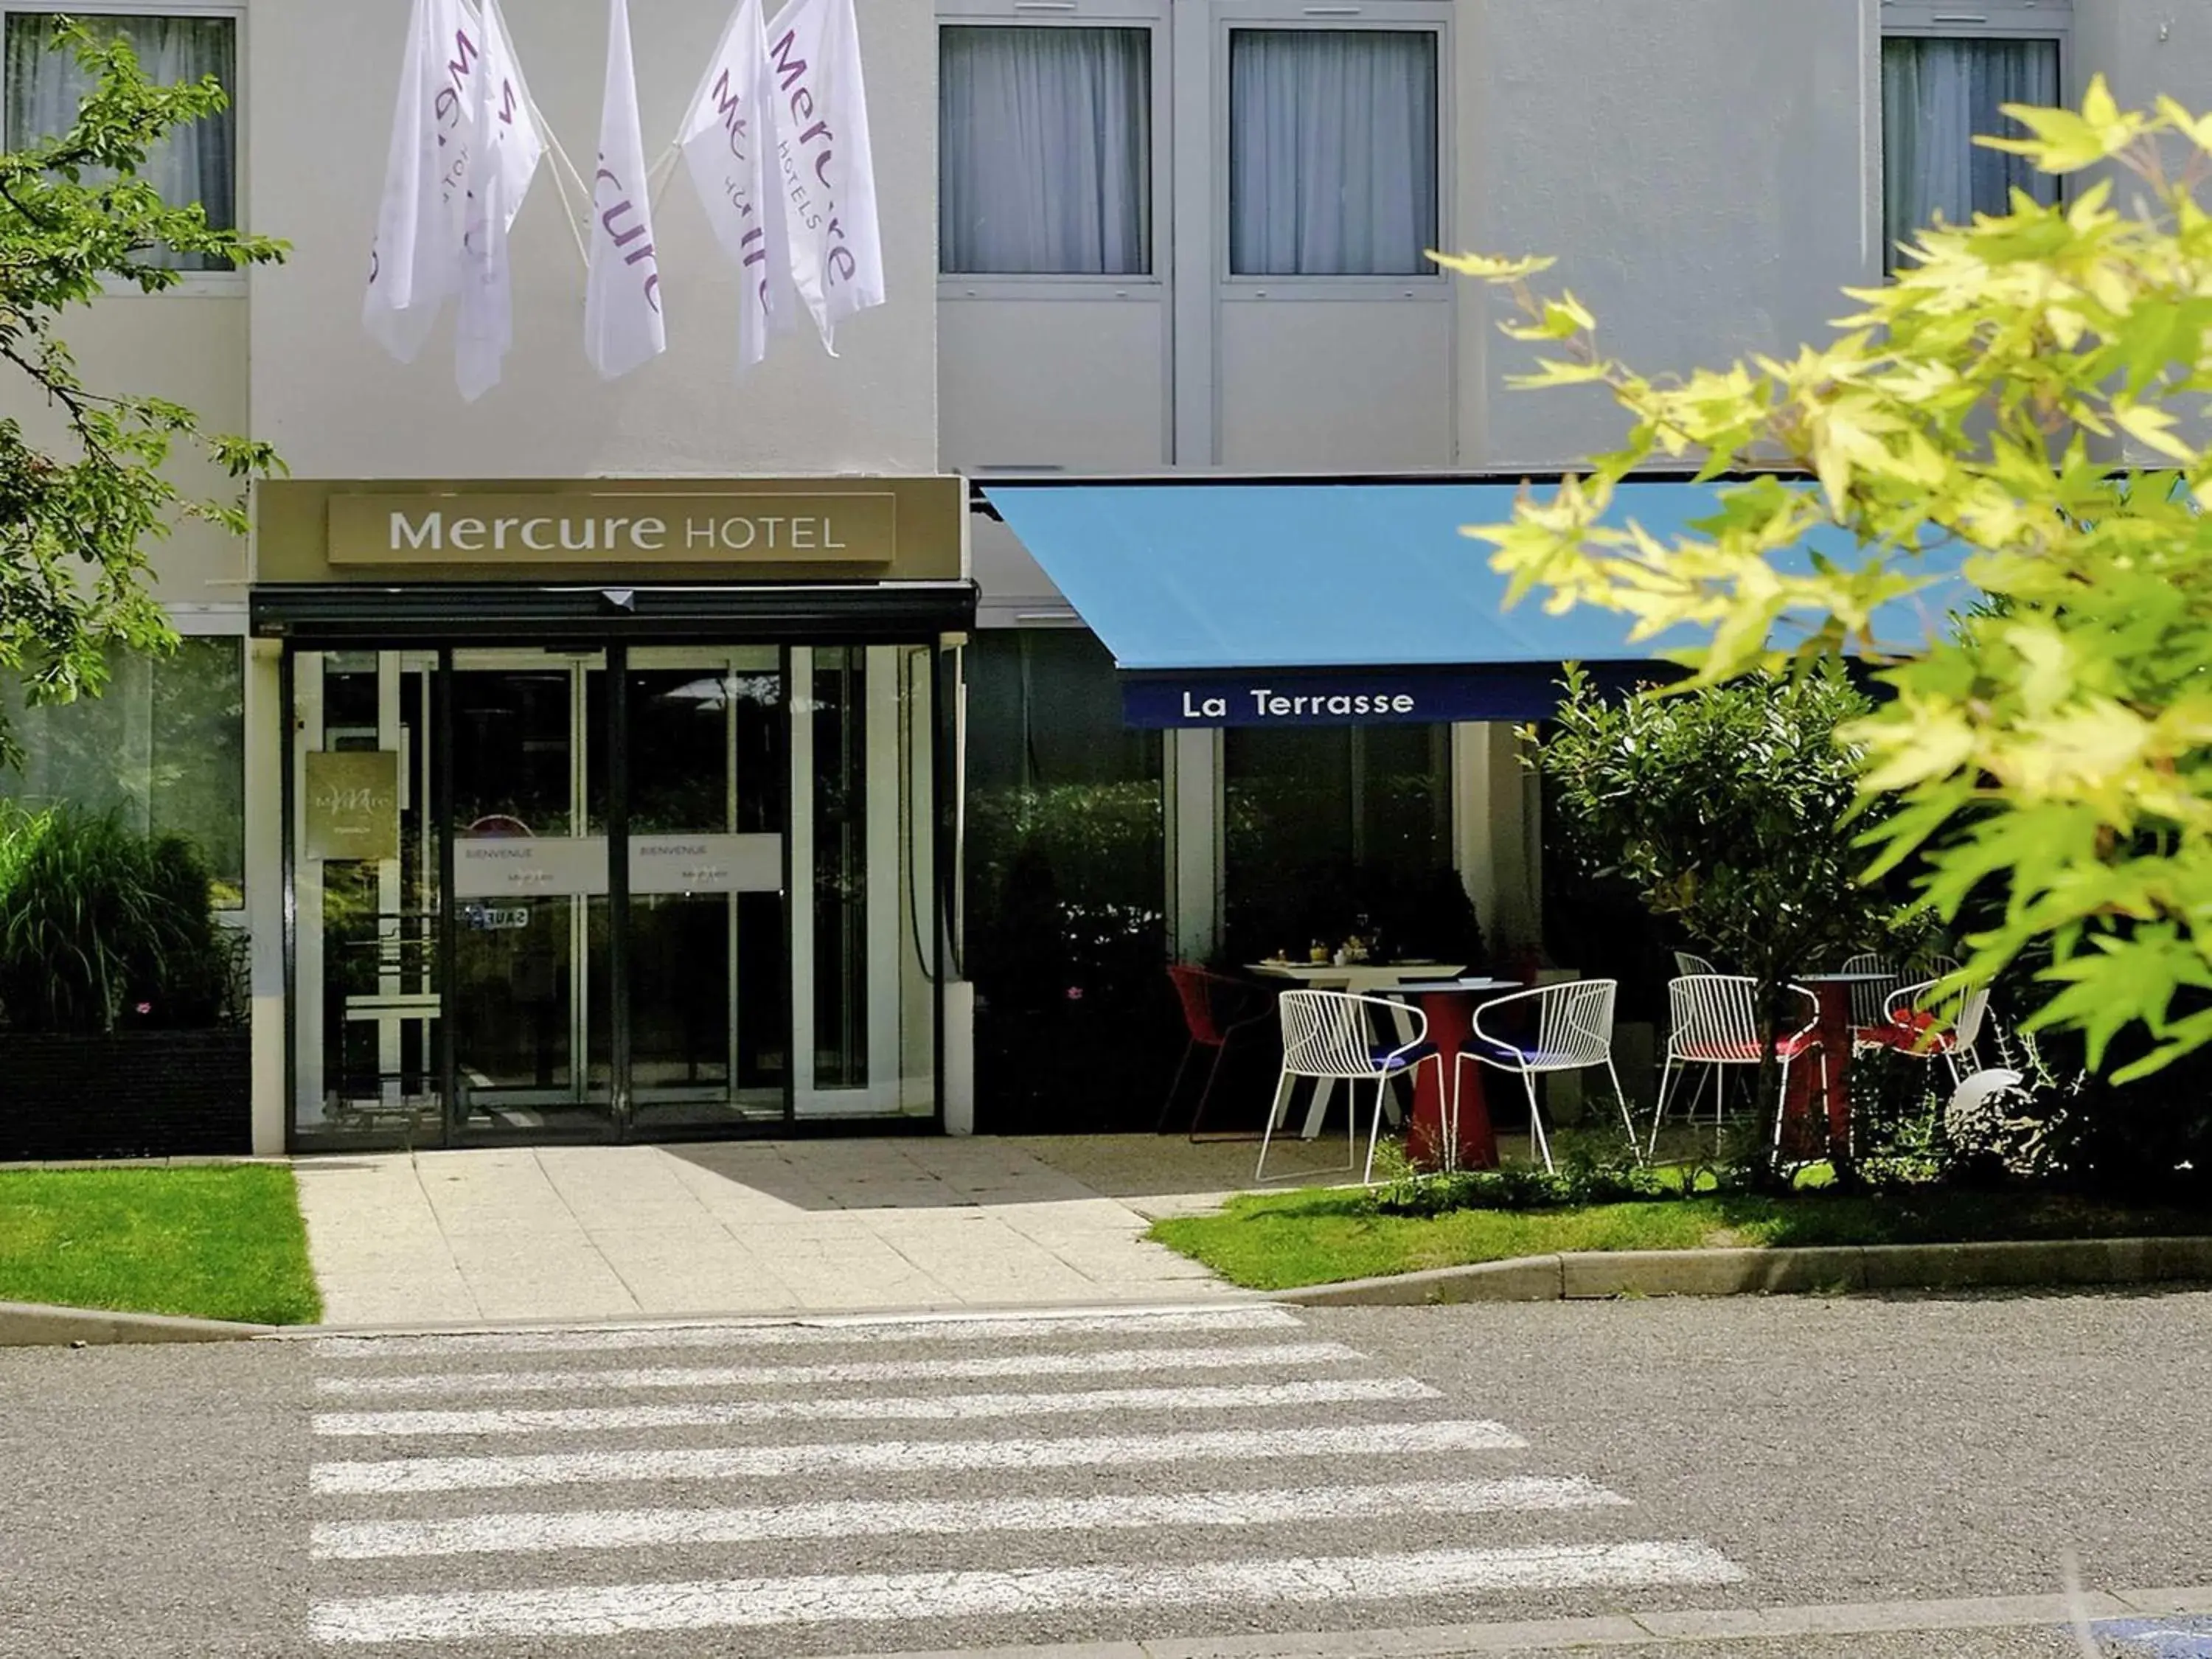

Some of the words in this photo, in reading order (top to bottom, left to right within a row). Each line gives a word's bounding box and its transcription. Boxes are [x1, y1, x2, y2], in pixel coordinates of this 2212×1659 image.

[778, 140, 822, 231] HOTELS
[389, 511, 666, 550] Mercure
[686, 518, 846, 549] HOTEL
[1182, 692, 1226, 717] La
[1250, 689, 1415, 717] Terrasse
[465, 848, 534, 860] BIENVENUE
[639, 845, 707, 856] BIENVENUE
